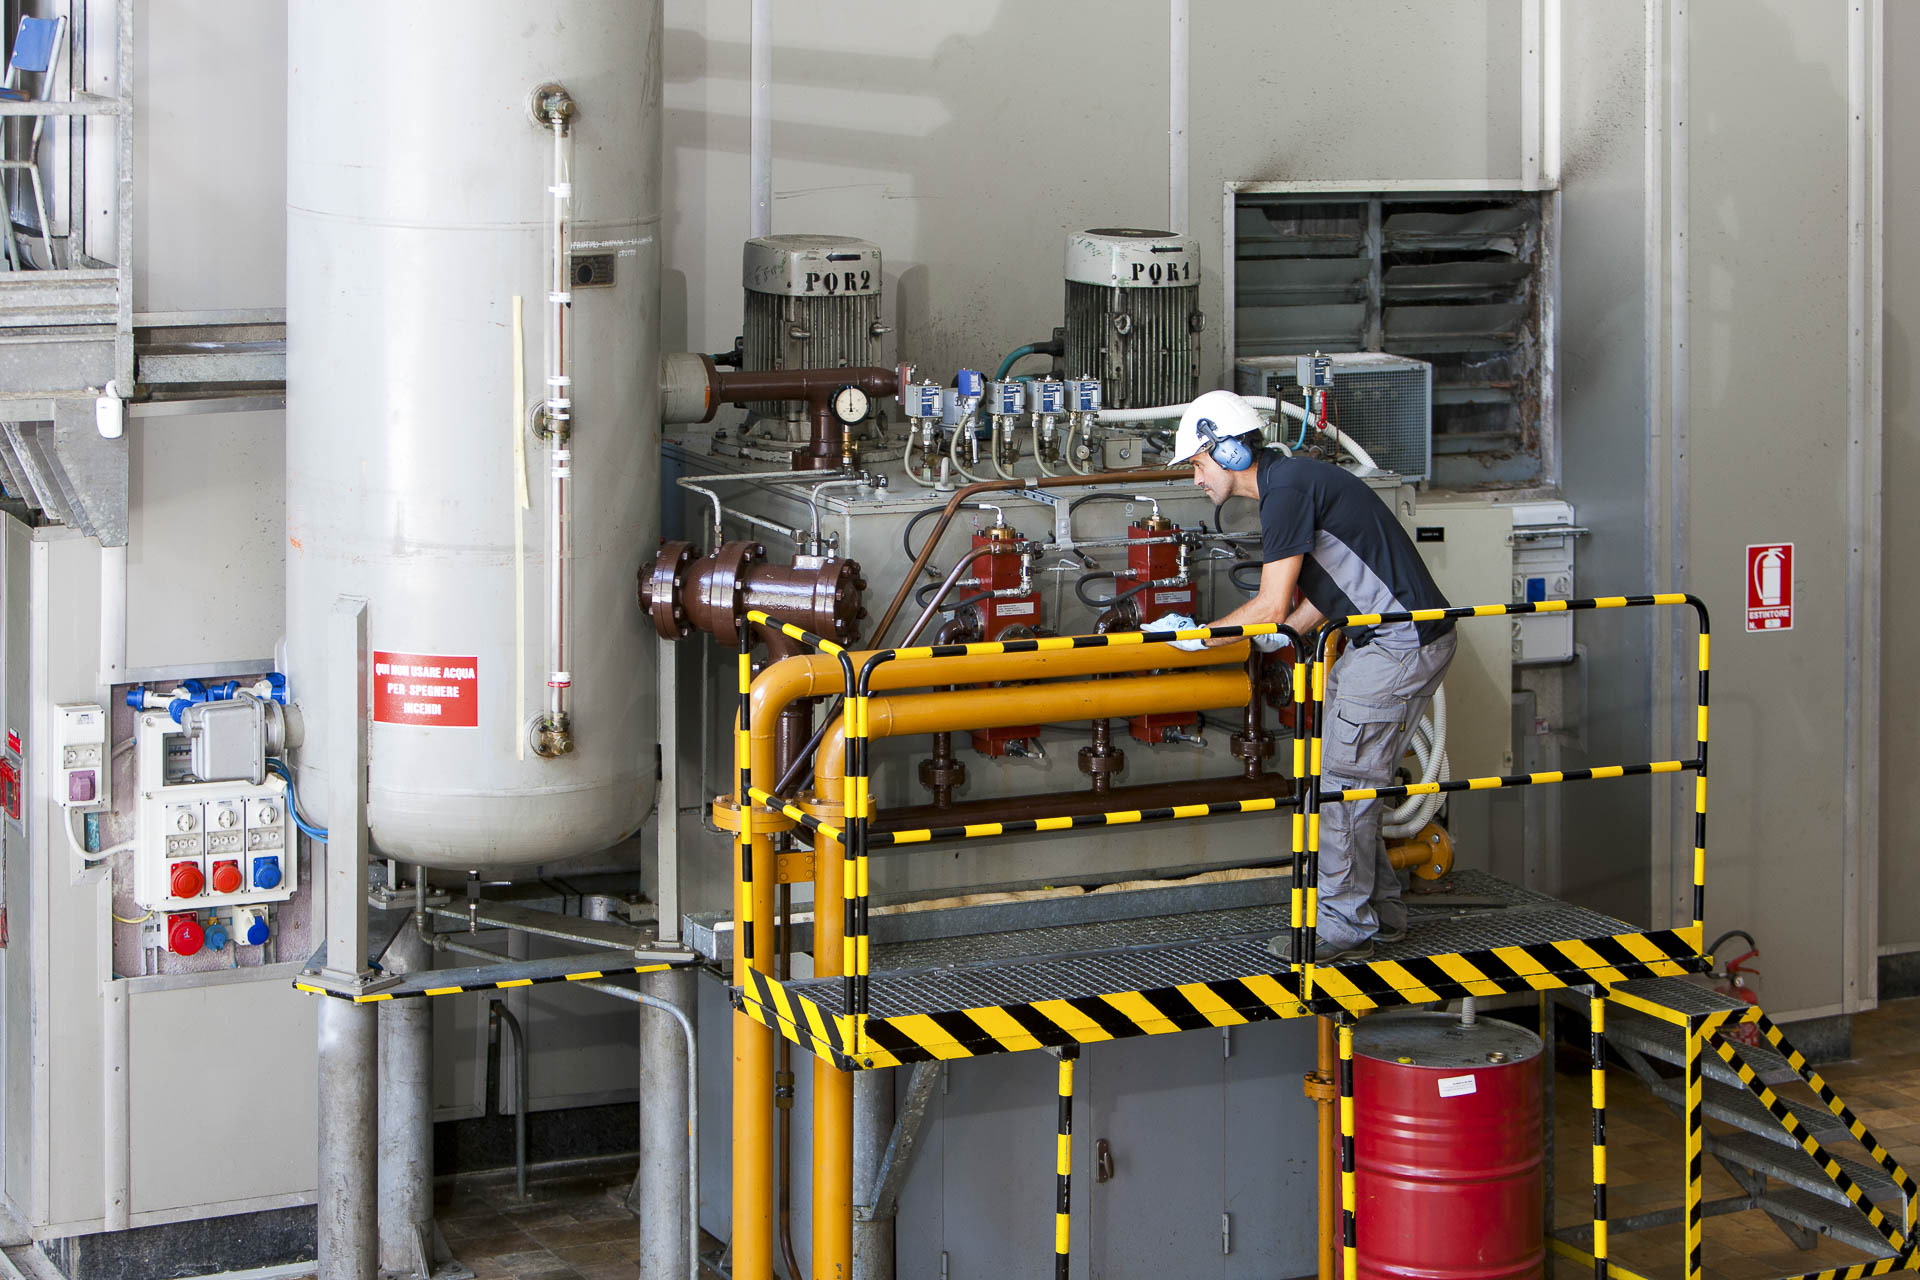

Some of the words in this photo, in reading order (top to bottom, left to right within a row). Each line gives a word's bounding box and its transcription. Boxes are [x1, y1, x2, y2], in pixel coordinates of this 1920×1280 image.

[1131, 262, 1190, 285] PQR1
[805, 270, 870, 295] PQR2
[1749, 609, 1790, 620] ESTINTORE
[375, 663, 390, 677] QUI
[390, 664, 410, 677] NON
[410, 665, 442, 679] USARE
[442, 667, 476, 681] ACQUA
[387, 682, 406, 696] PER
[408, 684, 460, 699] SPEGNERE
[403, 702, 442, 716] INCENDI
